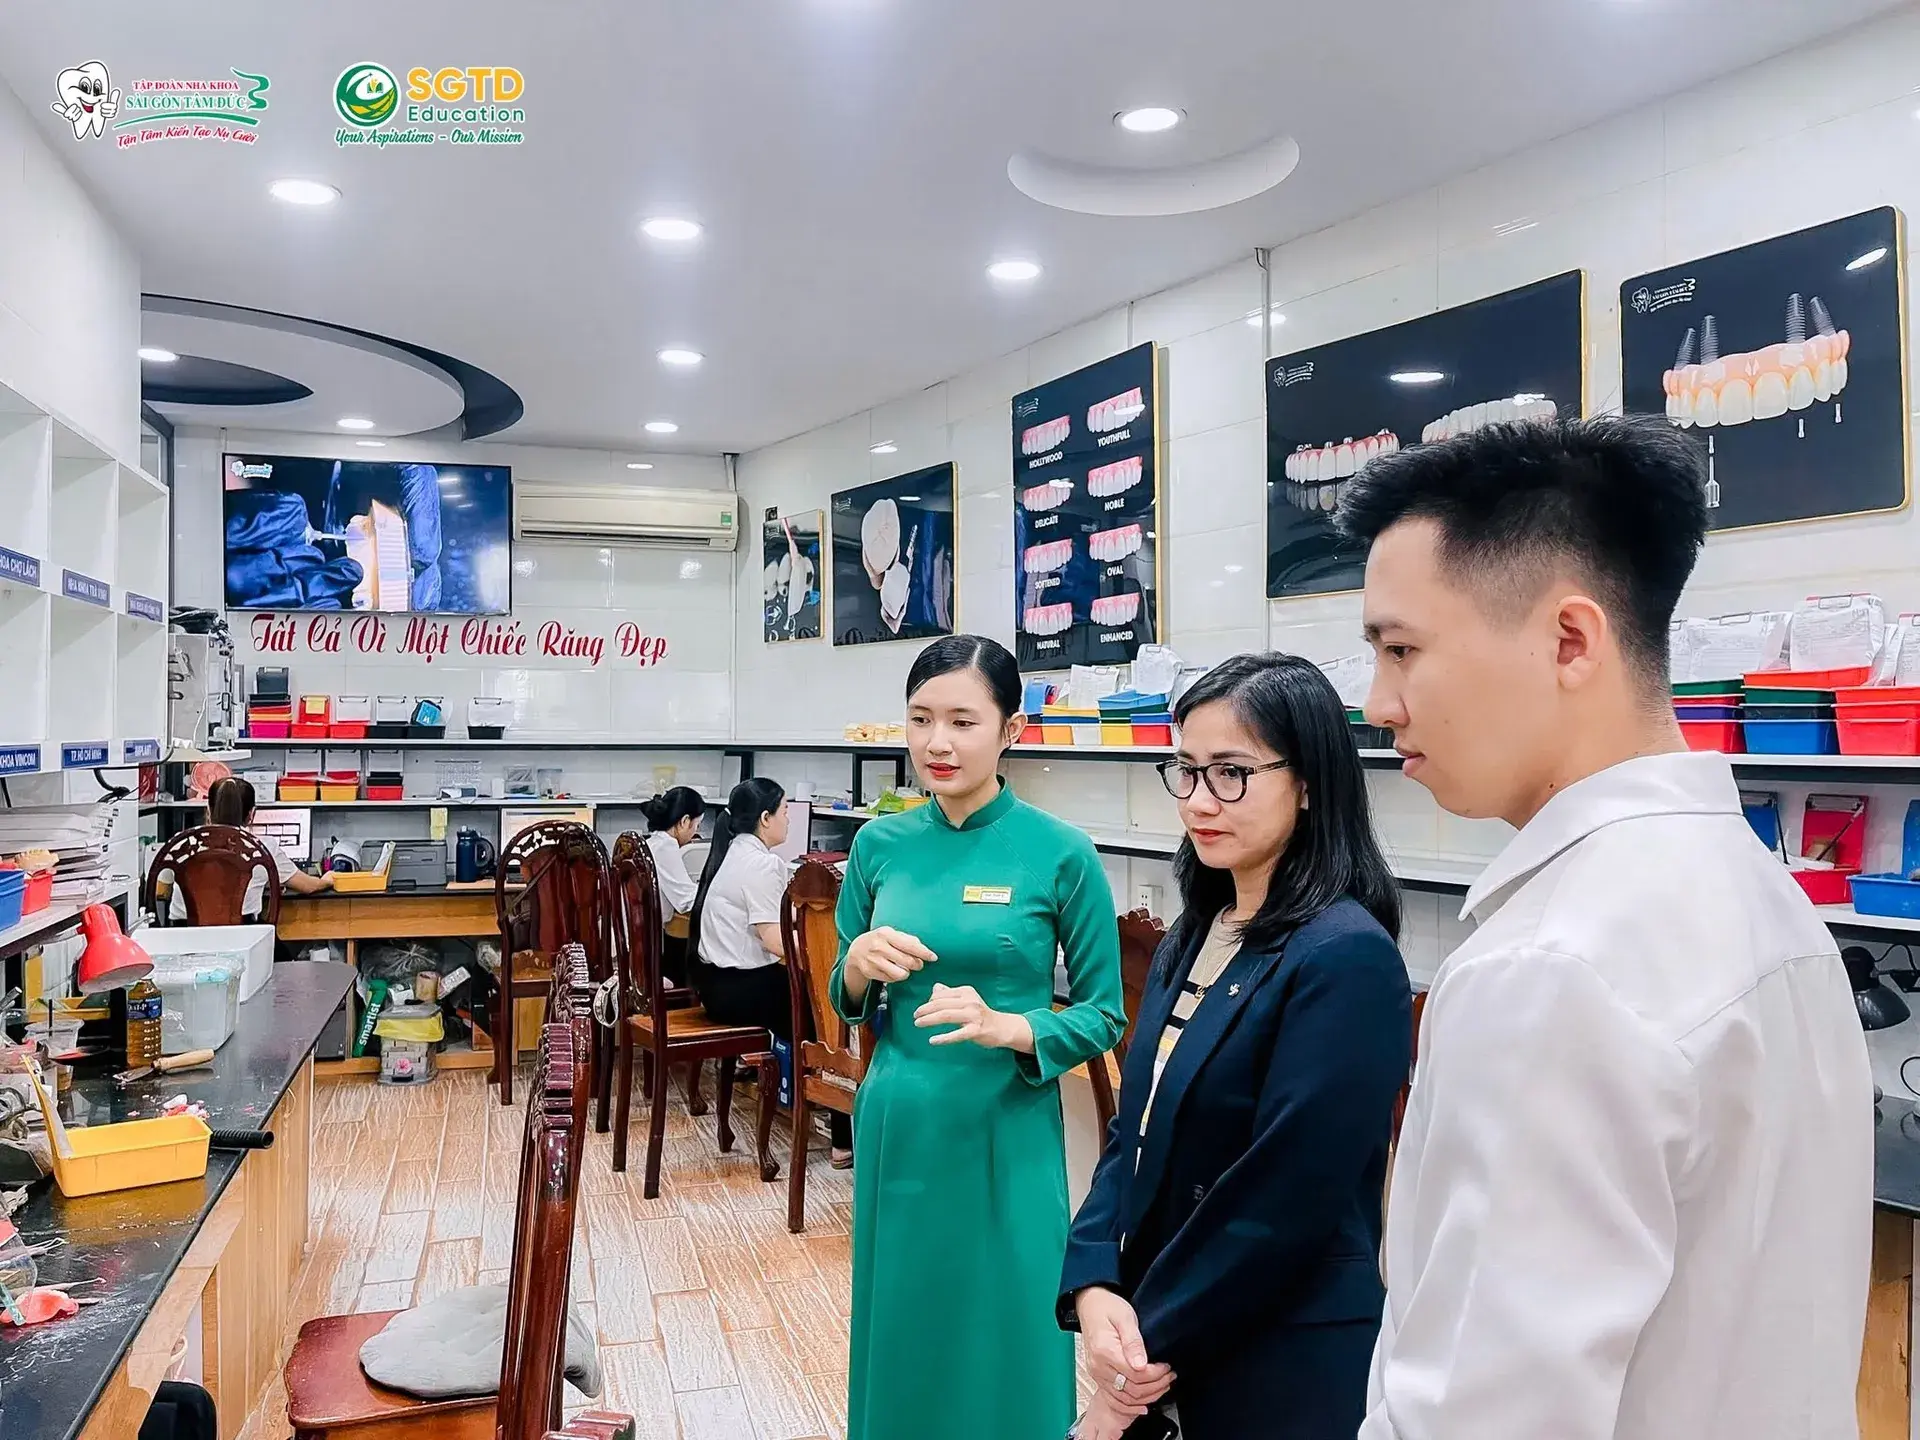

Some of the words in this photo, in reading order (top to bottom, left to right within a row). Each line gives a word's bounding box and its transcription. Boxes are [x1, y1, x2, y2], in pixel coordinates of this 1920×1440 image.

[1097, 429, 1131, 447] YOUTHFULL
[1029, 451, 1063, 469] HOLLYWOOD
[1104, 498, 1125, 511] NOBLE
[1034, 514, 1059, 529] DELICATE
[23, 560, 37, 579] LÁCH
[1107, 565, 1124, 577] OVAL
[78, 580, 89, 596] KHOA
[1034, 577, 1061, 590] SOFTENED
[250, 613, 297, 652] Tất
[307, 614, 342, 653] Cả
[349, 615, 387, 653] Vì
[396, 616, 450, 663] Một
[461, 617, 527, 656] Chiếc
[536, 620, 605, 666] Răng
[614, 621, 669, 667] Đẹp
[1100, 630, 1134, 644] ENHANCED
[1036, 639, 1061, 651] NATURAL
[15, 752, 36, 767] VINCOM
[358, 1003, 381, 1046] smartist
